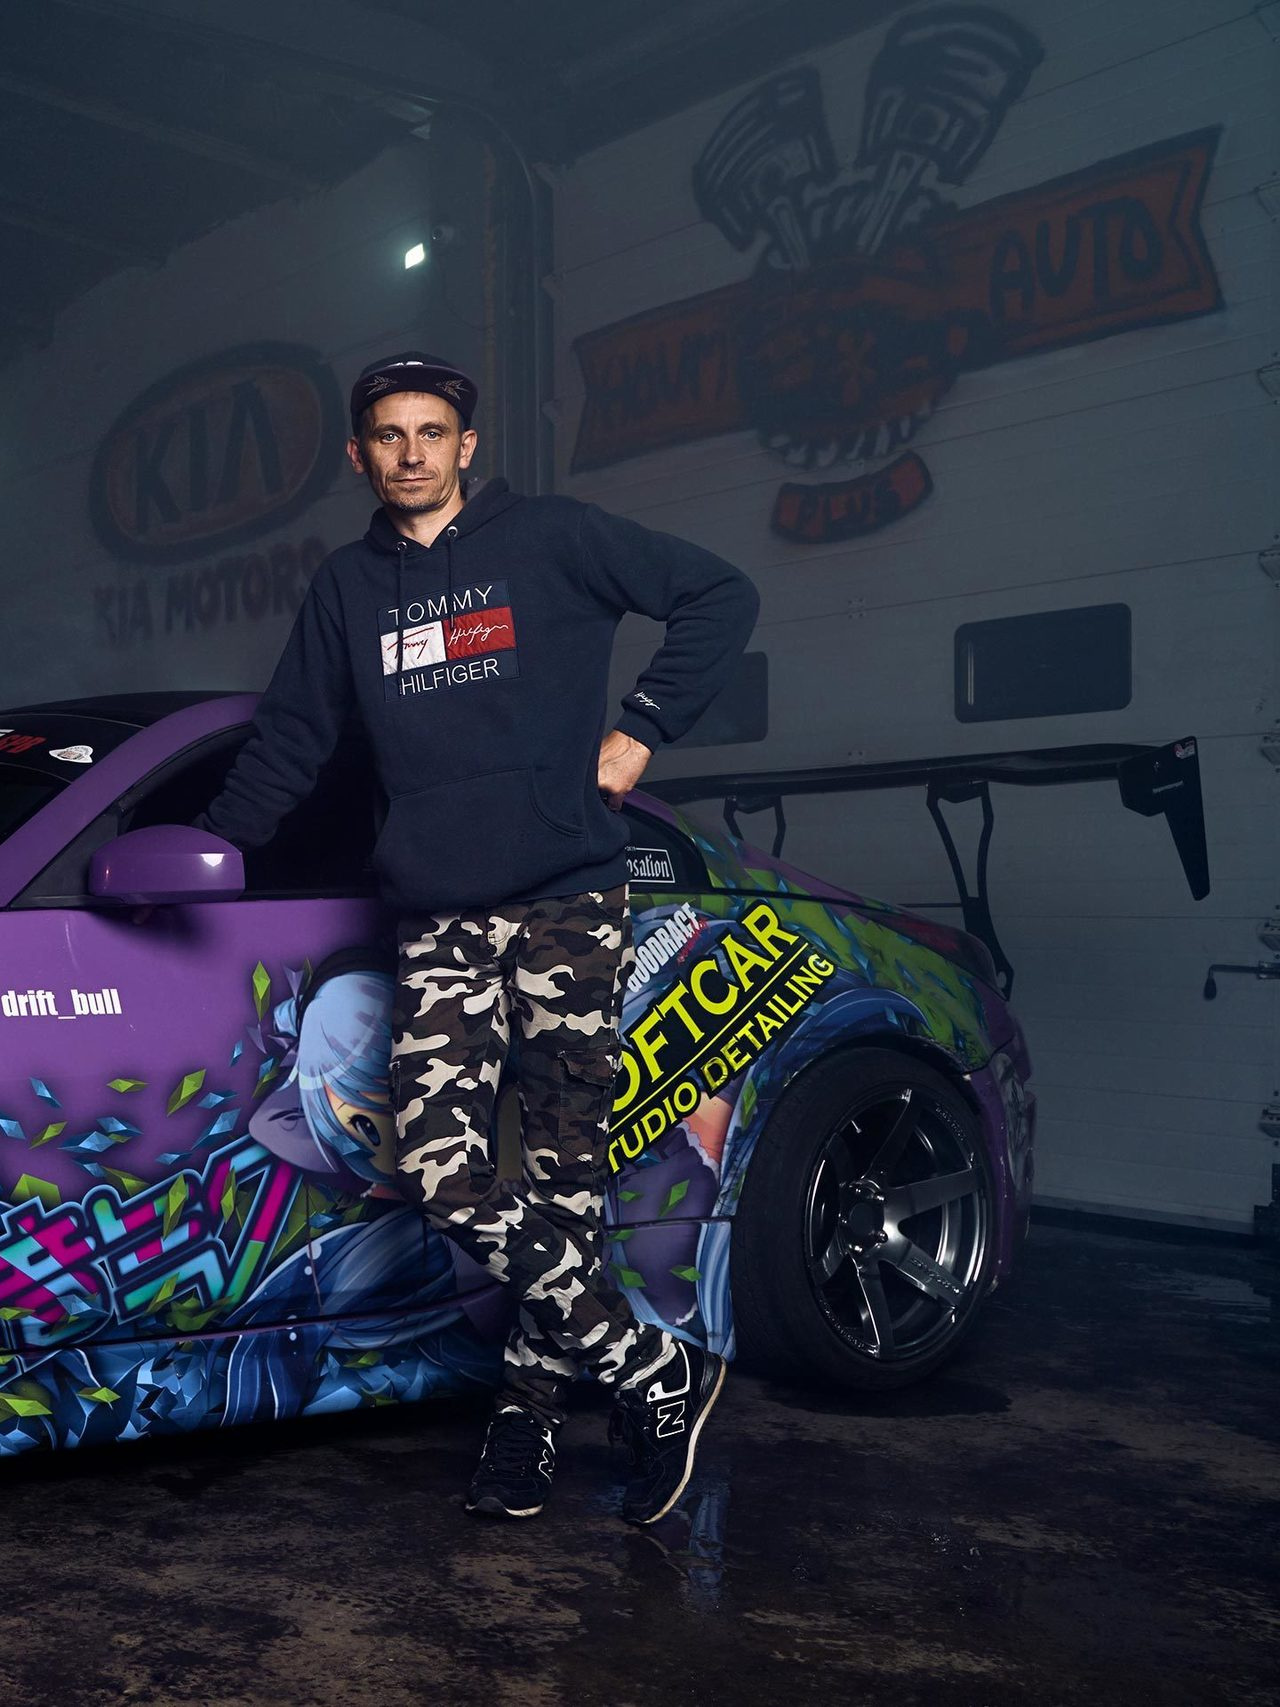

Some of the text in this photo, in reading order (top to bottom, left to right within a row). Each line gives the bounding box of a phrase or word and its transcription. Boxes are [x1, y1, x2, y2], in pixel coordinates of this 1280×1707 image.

[987, 196, 1164, 324] AUTO
[134, 377, 284, 535] KIA
[94, 578, 153, 640] KIA
[387, 585, 493, 626] TOMMY
[400, 658, 501, 696] HILFIGER
[626, 853, 670, 878] osation
[0, 988, 123, 1020] drift_bull
[612, 904, 799, 1112] OFTCAR
[607, 953, 835, 1174] TUDIO DETAILING
